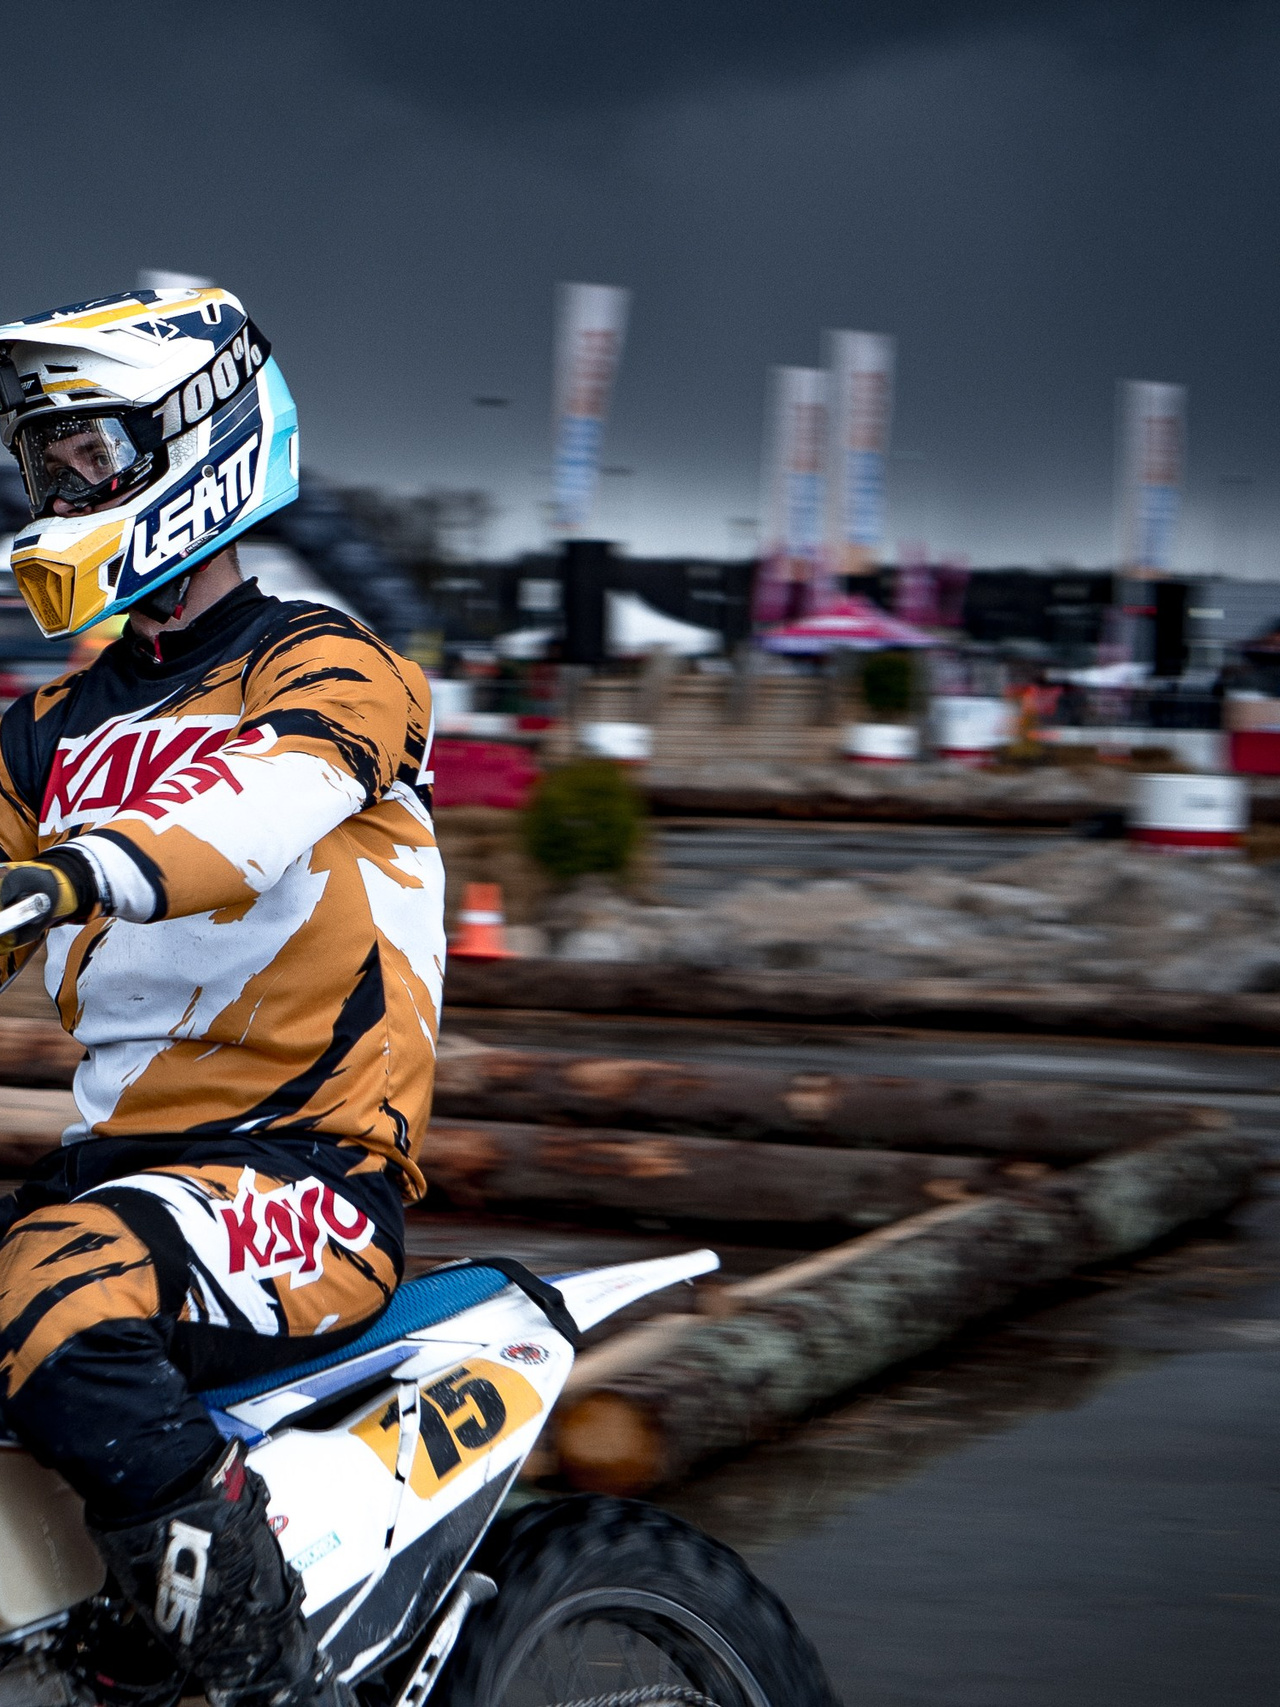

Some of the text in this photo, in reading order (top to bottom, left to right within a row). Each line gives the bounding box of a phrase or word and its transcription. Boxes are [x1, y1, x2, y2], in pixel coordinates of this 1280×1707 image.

[152, 325, 263, 441] 100%
[133, 433, 259, 576] LEATT
[220, 1185, 368, 1274] KAYO
